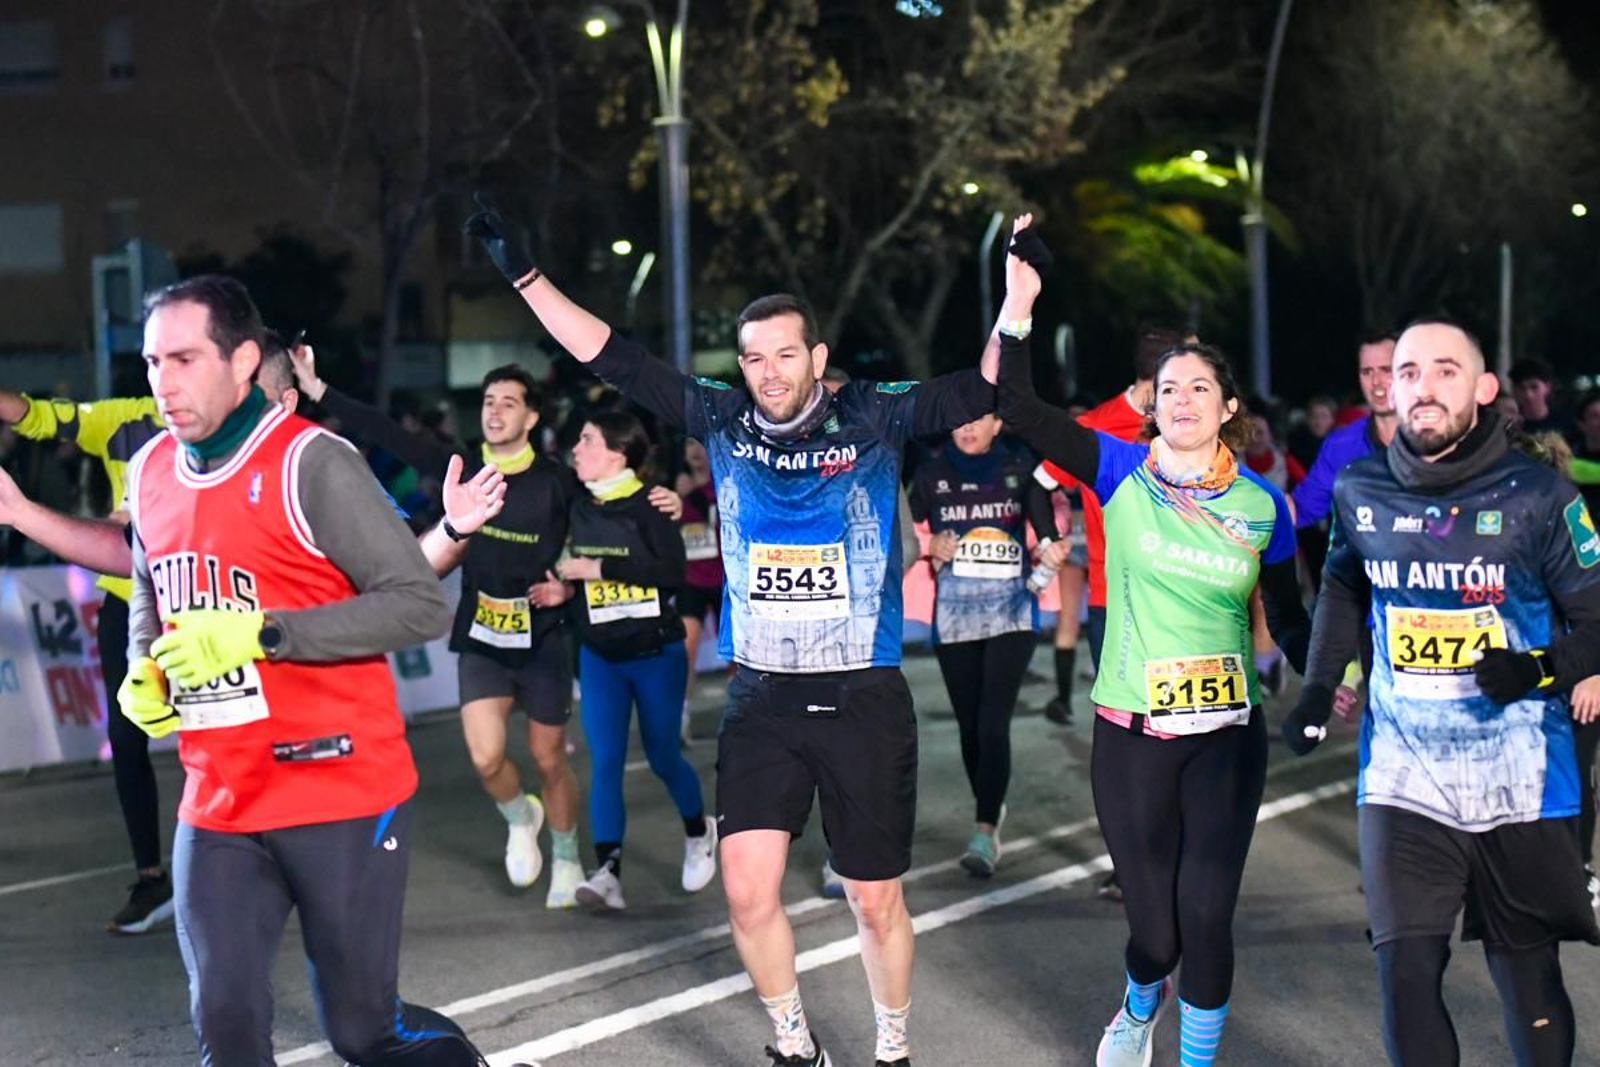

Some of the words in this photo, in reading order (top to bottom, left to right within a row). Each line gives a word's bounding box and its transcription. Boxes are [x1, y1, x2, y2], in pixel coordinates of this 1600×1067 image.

[776, 444, 857, 470] ANTÓN
[940, 505, 967, 522] SAN
[960, 542, 1019, 559] 10199
[1167, 542, 1249, 576] SAKATA
[756, 566, 837, 592] 5543
[1406, 556, 1505, 591] ANTÓN
[1459, 583, 1506, 604] 2025
[31, 598, 83, 657] 42
[1398, 632, 1492, 664] 3474
[1156, 675, 1236, 707] 3151
